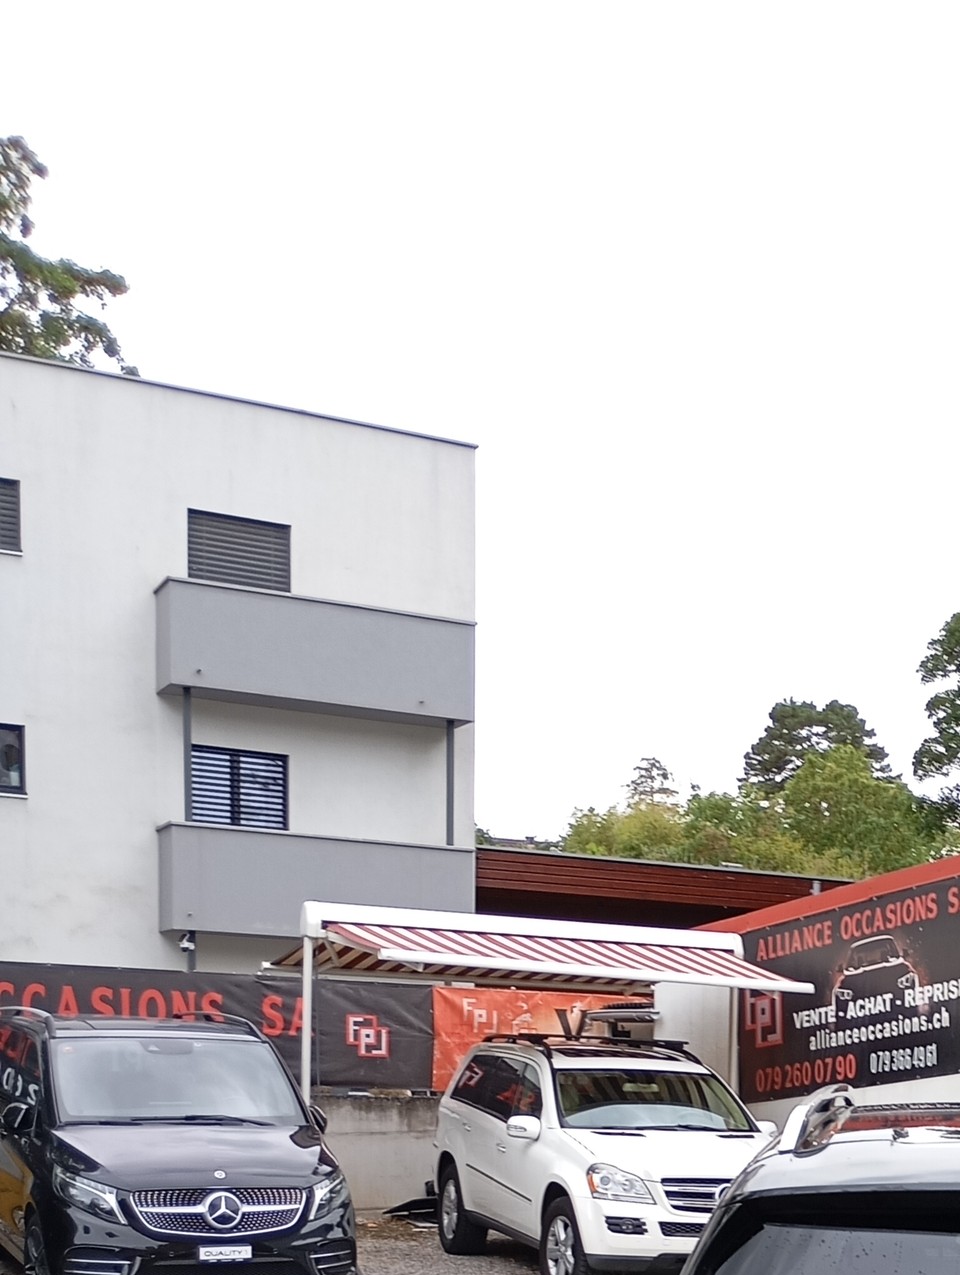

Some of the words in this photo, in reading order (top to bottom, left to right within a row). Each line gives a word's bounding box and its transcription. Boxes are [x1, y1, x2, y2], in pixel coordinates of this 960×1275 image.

[757, 920, 833, 962] ALLIANCE
[840, 892, 938, 940] OCCASIONS
[792, 1005, 837, 1029] VENTE
[846, 993, 893, 1019] ACHAT
[809, 1006, 950, 1050] allianceoccasions.ch
